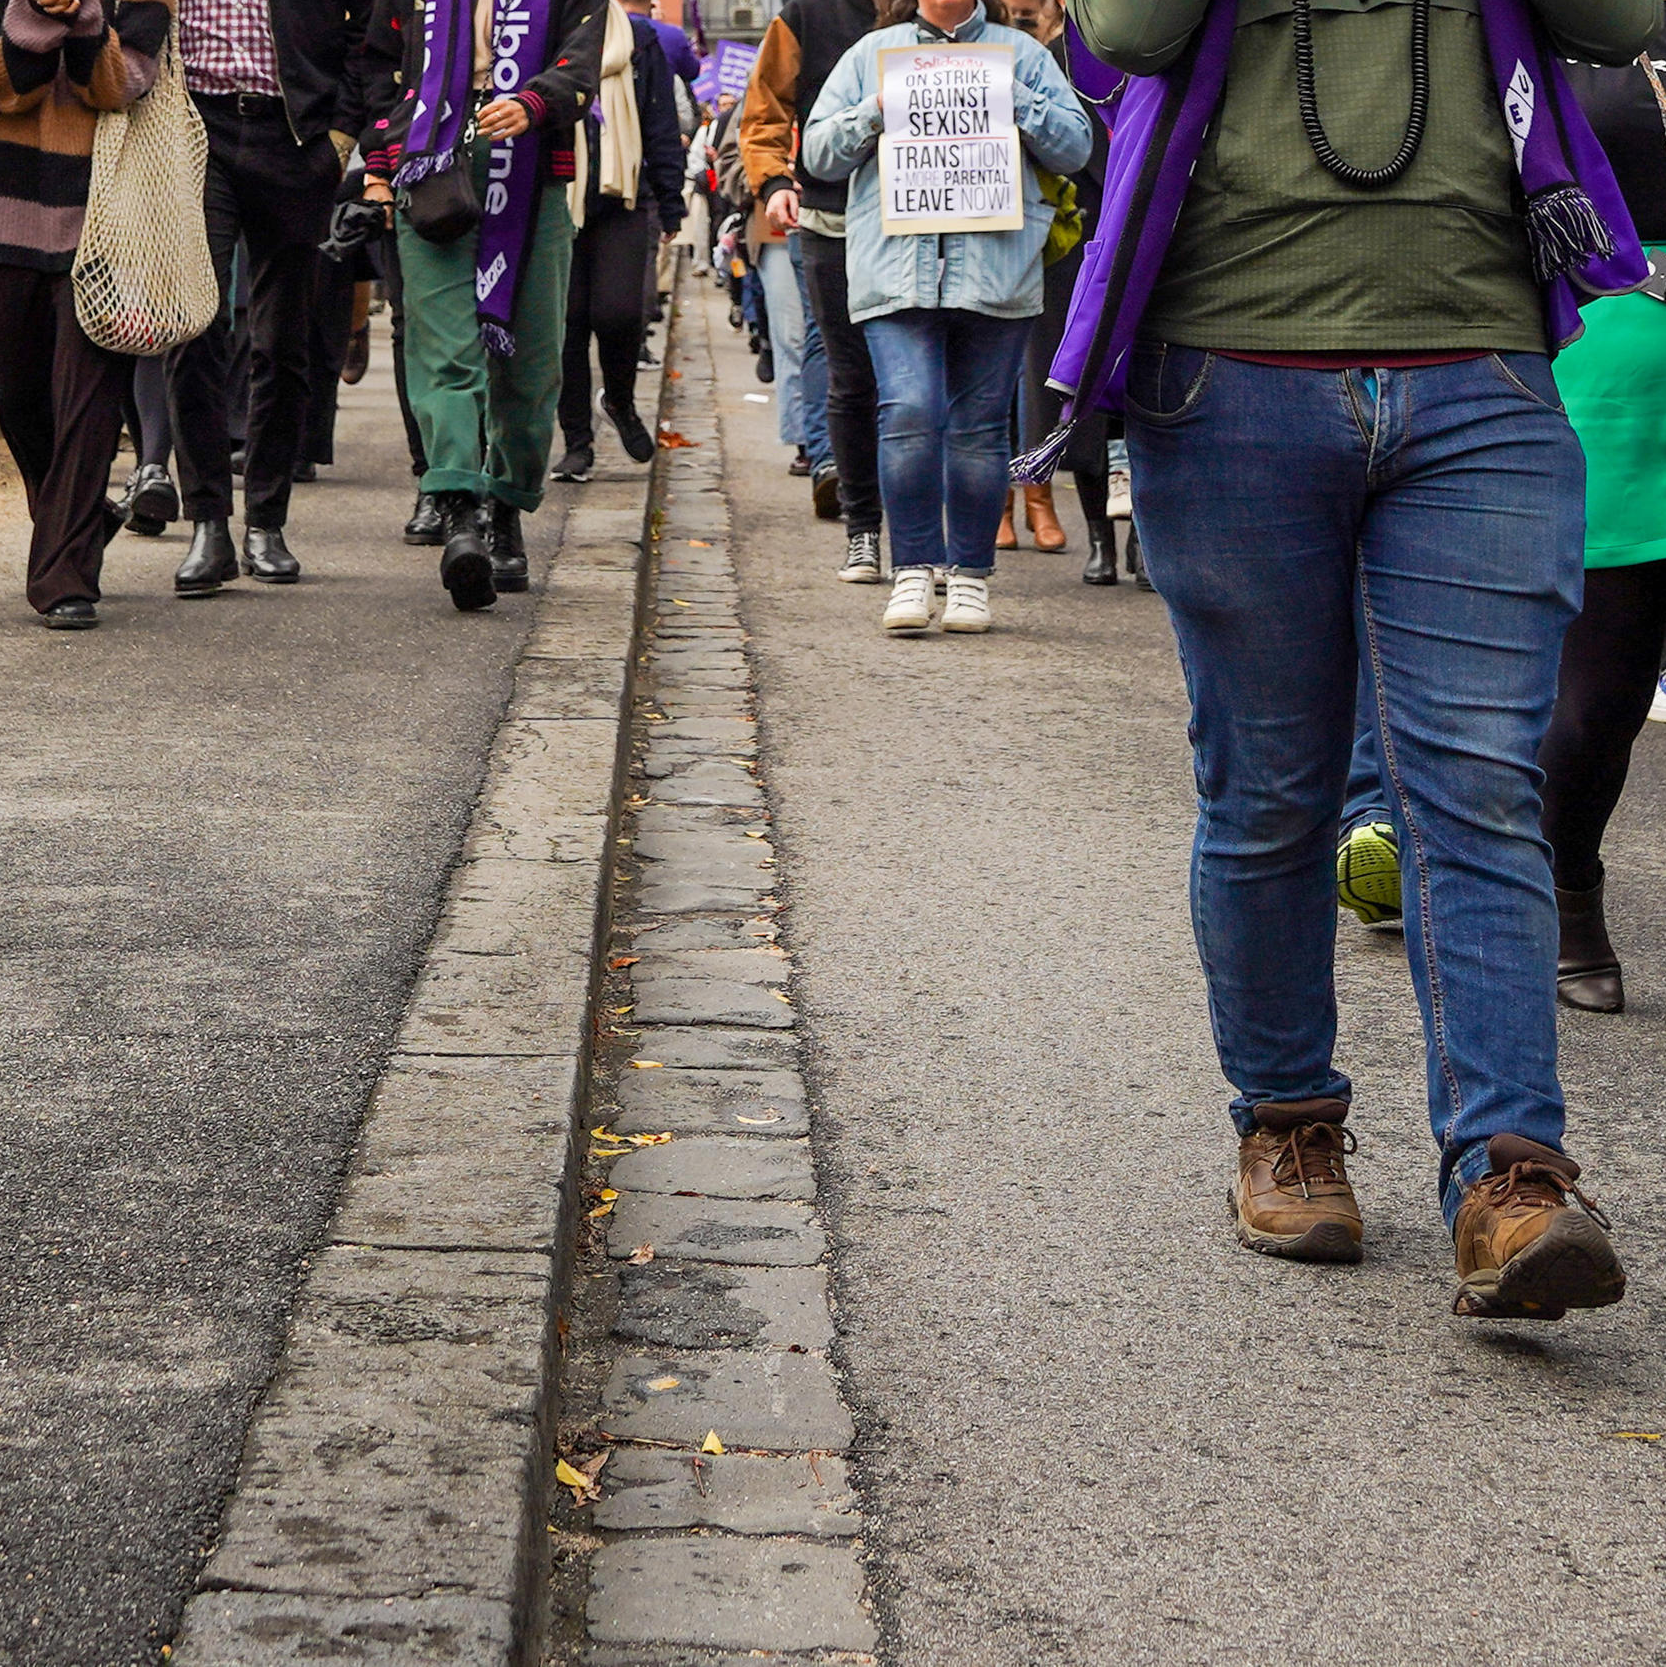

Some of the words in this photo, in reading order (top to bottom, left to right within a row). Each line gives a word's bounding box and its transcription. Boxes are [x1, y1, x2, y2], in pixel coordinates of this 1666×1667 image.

[906, 74, 928, 87] ON
[933, 69, 992, 86] STRIKE
[909, 86, 989, 109] AGAINST
[910, 110, 991, 137] SEXISM
[893, 142, 1010, 170] TRANSITION
[905, 171, 940, 187] MORE
[944, 169, 1010, 186] PARENTAL
[895, 188, 954, 212] LEAVE
[961, 187, 1011, 211] NOW!
